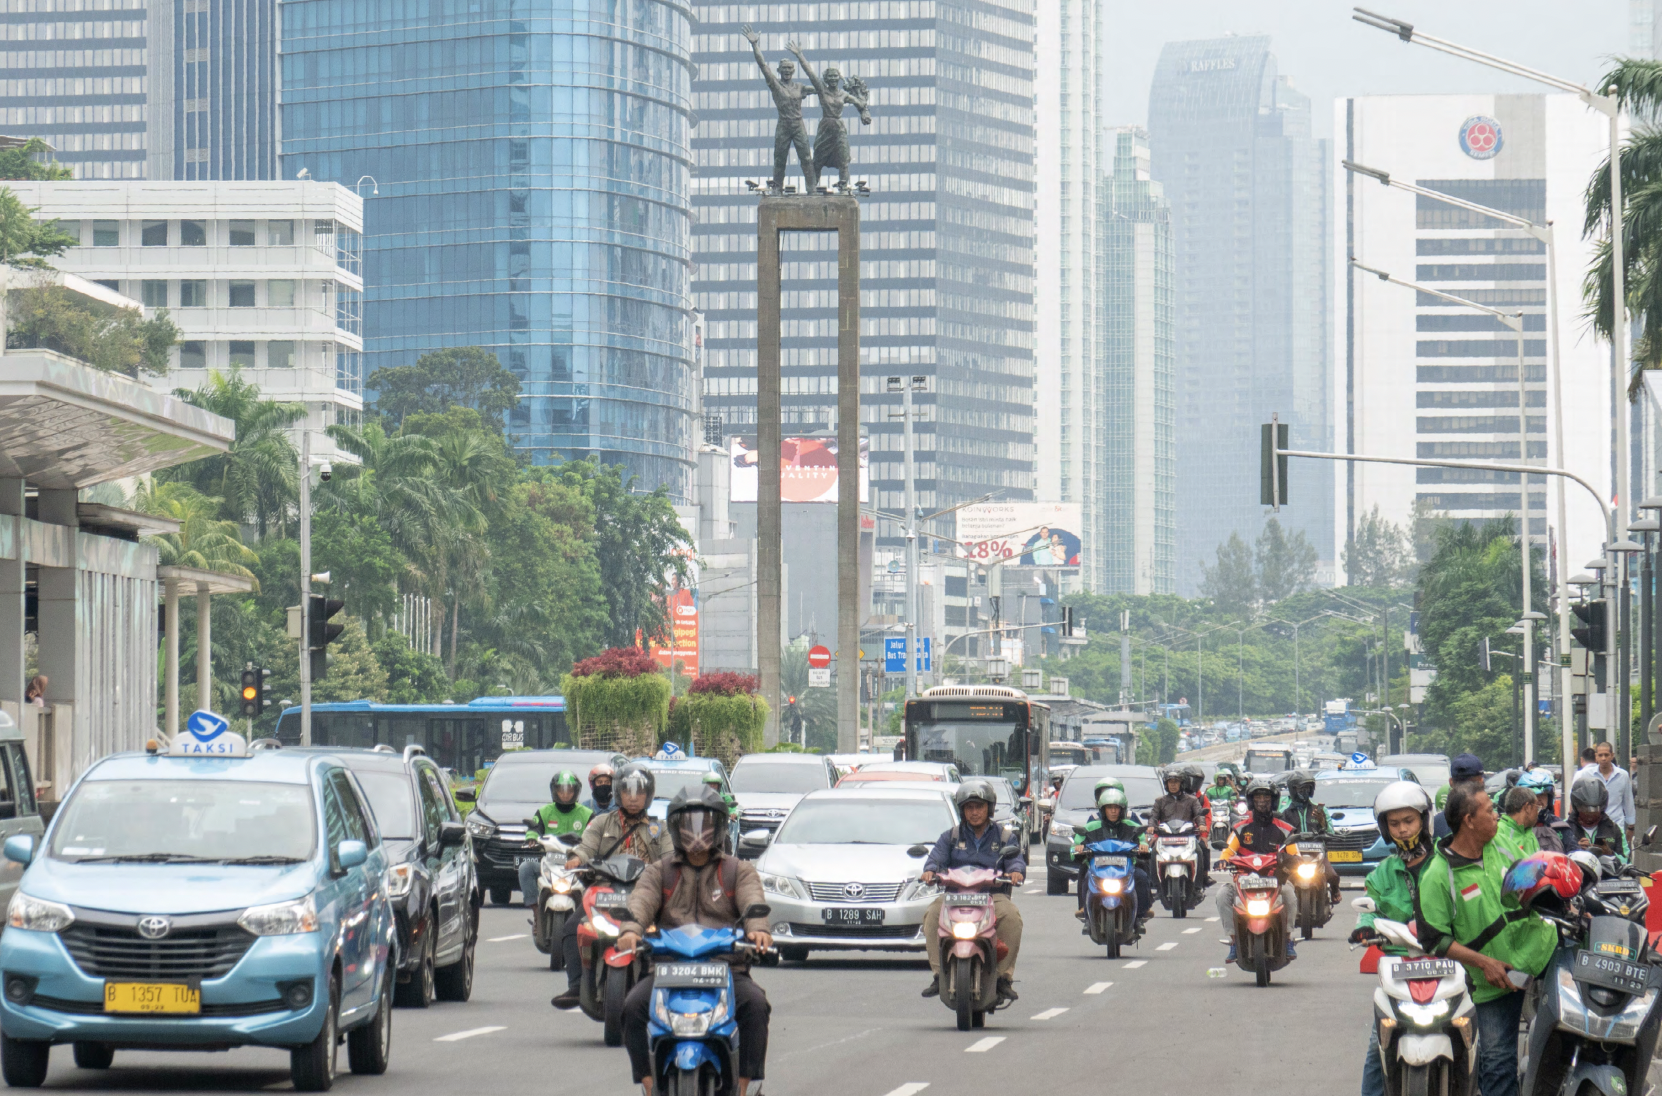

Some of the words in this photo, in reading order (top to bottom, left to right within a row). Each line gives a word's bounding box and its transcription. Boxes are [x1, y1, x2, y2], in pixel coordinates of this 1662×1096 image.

[1191, 58, 1235, 72] RAFFLES
[962, 506, 1015, 514] KOINWORKS
[964, 541, 1013, 558] 18%
[891, 641, 904, 649] Jalur
[182, 744, 233, 753] TAKSI
[826, 909, 832, 920] B
[840, 909, 860, 920] 1289
[866, 909, 882, 920] SAH
[1406, 962, 1430, 971] 3710
[1436, 960, 1454, 969] PAU
[1582, 955, 1588, 966] B
[1595, 958, 1621, 973] 4903
[1626, 965, 1646, 980] BTE
[661, 967, 667, 976] B
[672, 967, 697, 976] 3204
[701, 967, 722, 976] BMK
[1630, 980, 1642, 989] 23
[108, 986, 116, 1001] B
[132, 986, 162, 1002] 1357
[174, 987, 196, 1003] TUA
